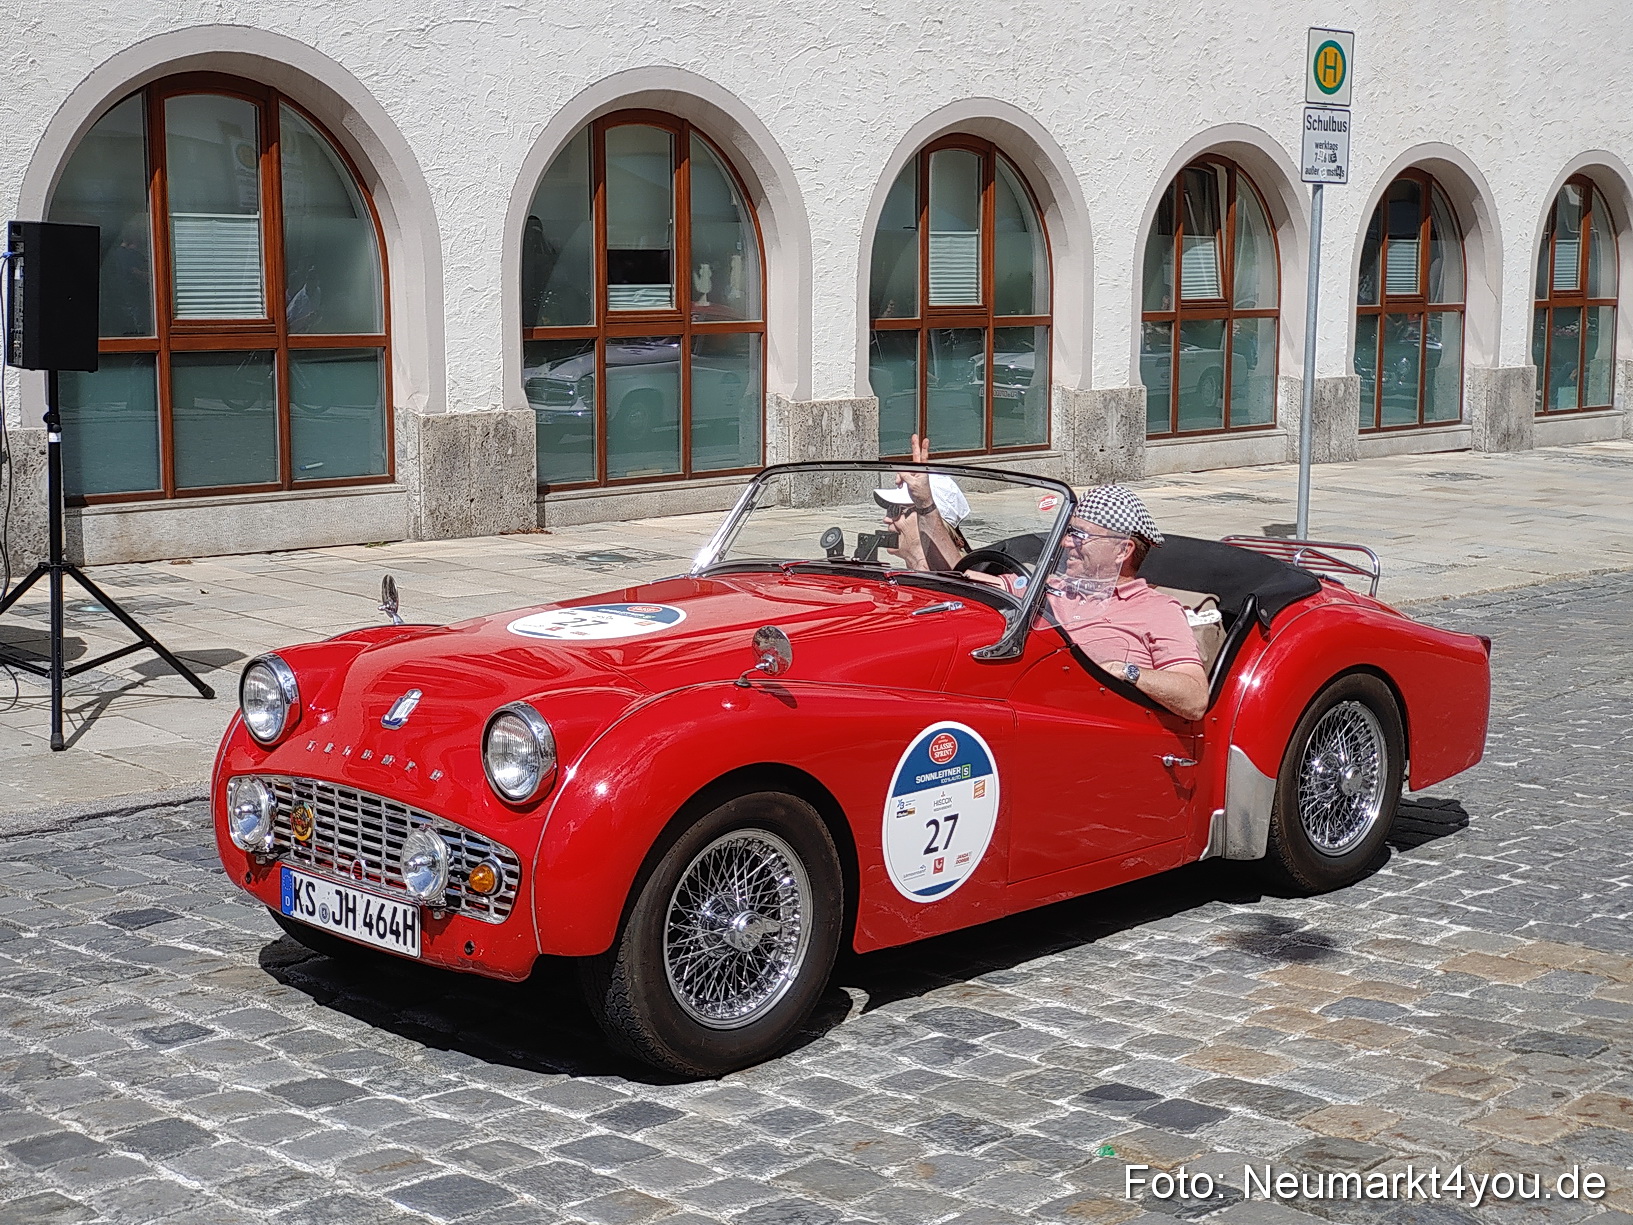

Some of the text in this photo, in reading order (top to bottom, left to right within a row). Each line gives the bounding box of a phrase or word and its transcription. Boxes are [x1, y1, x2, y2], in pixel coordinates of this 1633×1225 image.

[1323, 52, 1338, 83] H
[1306, 114, 1348, 133] Schulbus
[1314, 140, 1339, 151] werktags
[1305, 165, 1319, 176] außer
[932, 741, 955, 752] CLASSIC
[934, 749, 953, 759] SPRINT
[915, 766, 969, 784] SONNLEITNER S
[933, 797, 953, 807] HISCOX
[923, 813, 959, 855] 27
[285, 895, 291, 907] D
[293, 873, 416, 949] KS JH 464H
